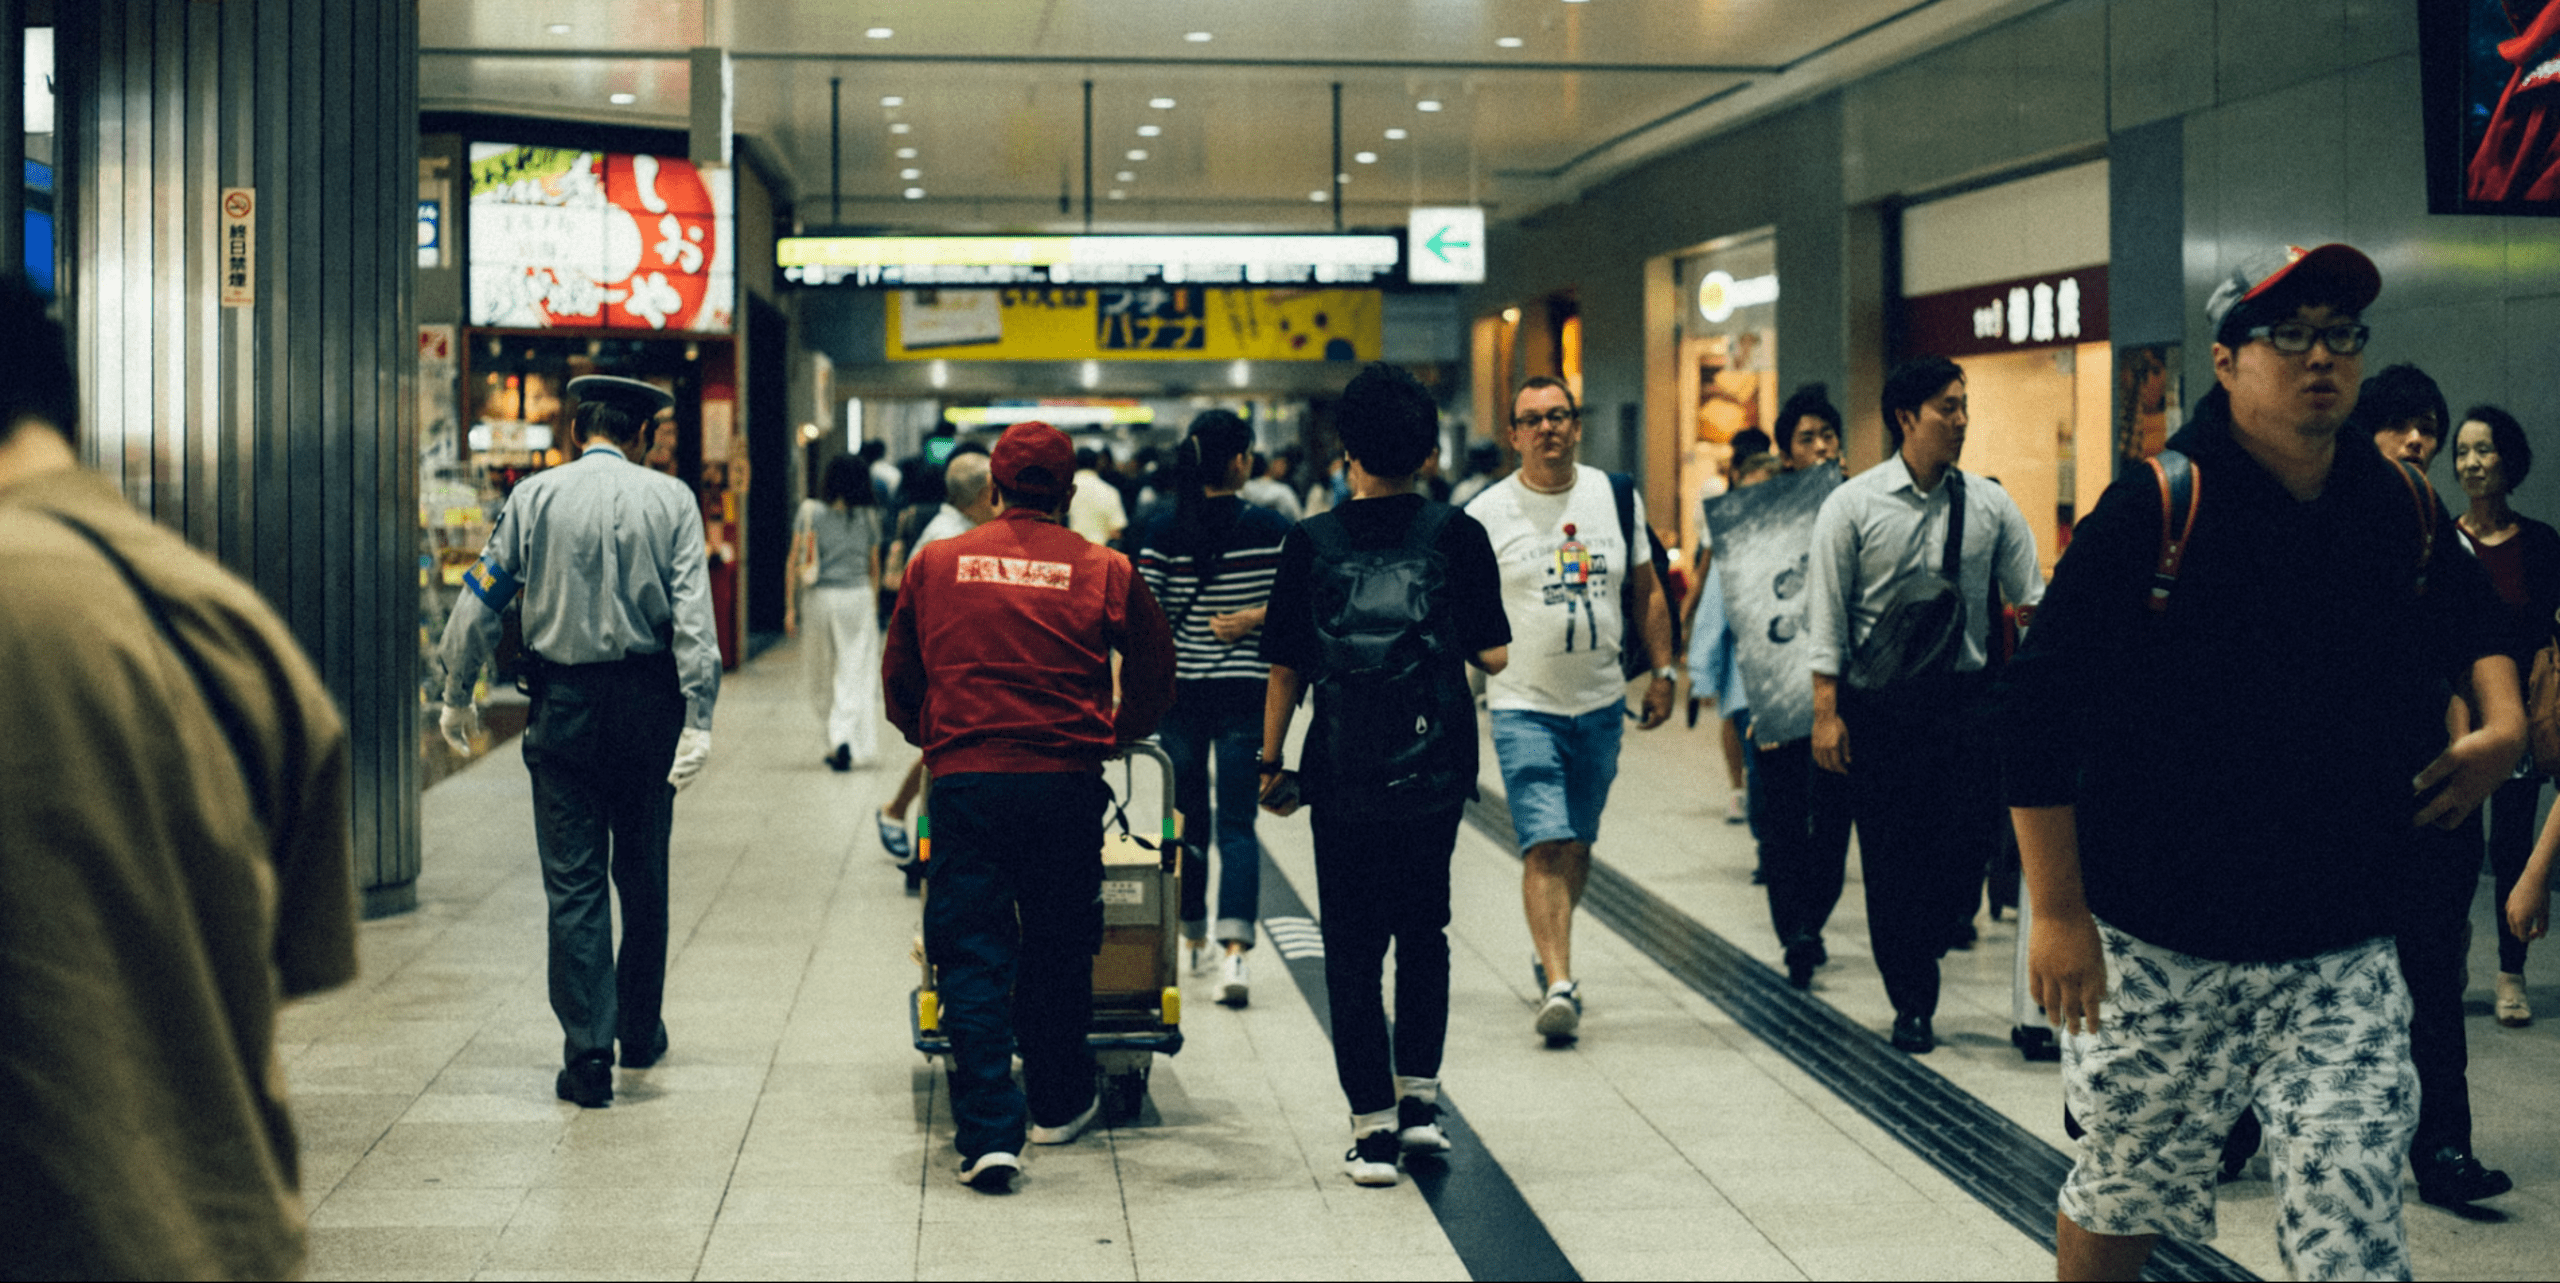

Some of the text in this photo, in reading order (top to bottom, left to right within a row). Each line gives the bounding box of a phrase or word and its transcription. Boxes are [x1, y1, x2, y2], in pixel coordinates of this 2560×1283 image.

[229, 225, 246, 288] 終日禁煙
[624, 154, 704, 330] しおや
